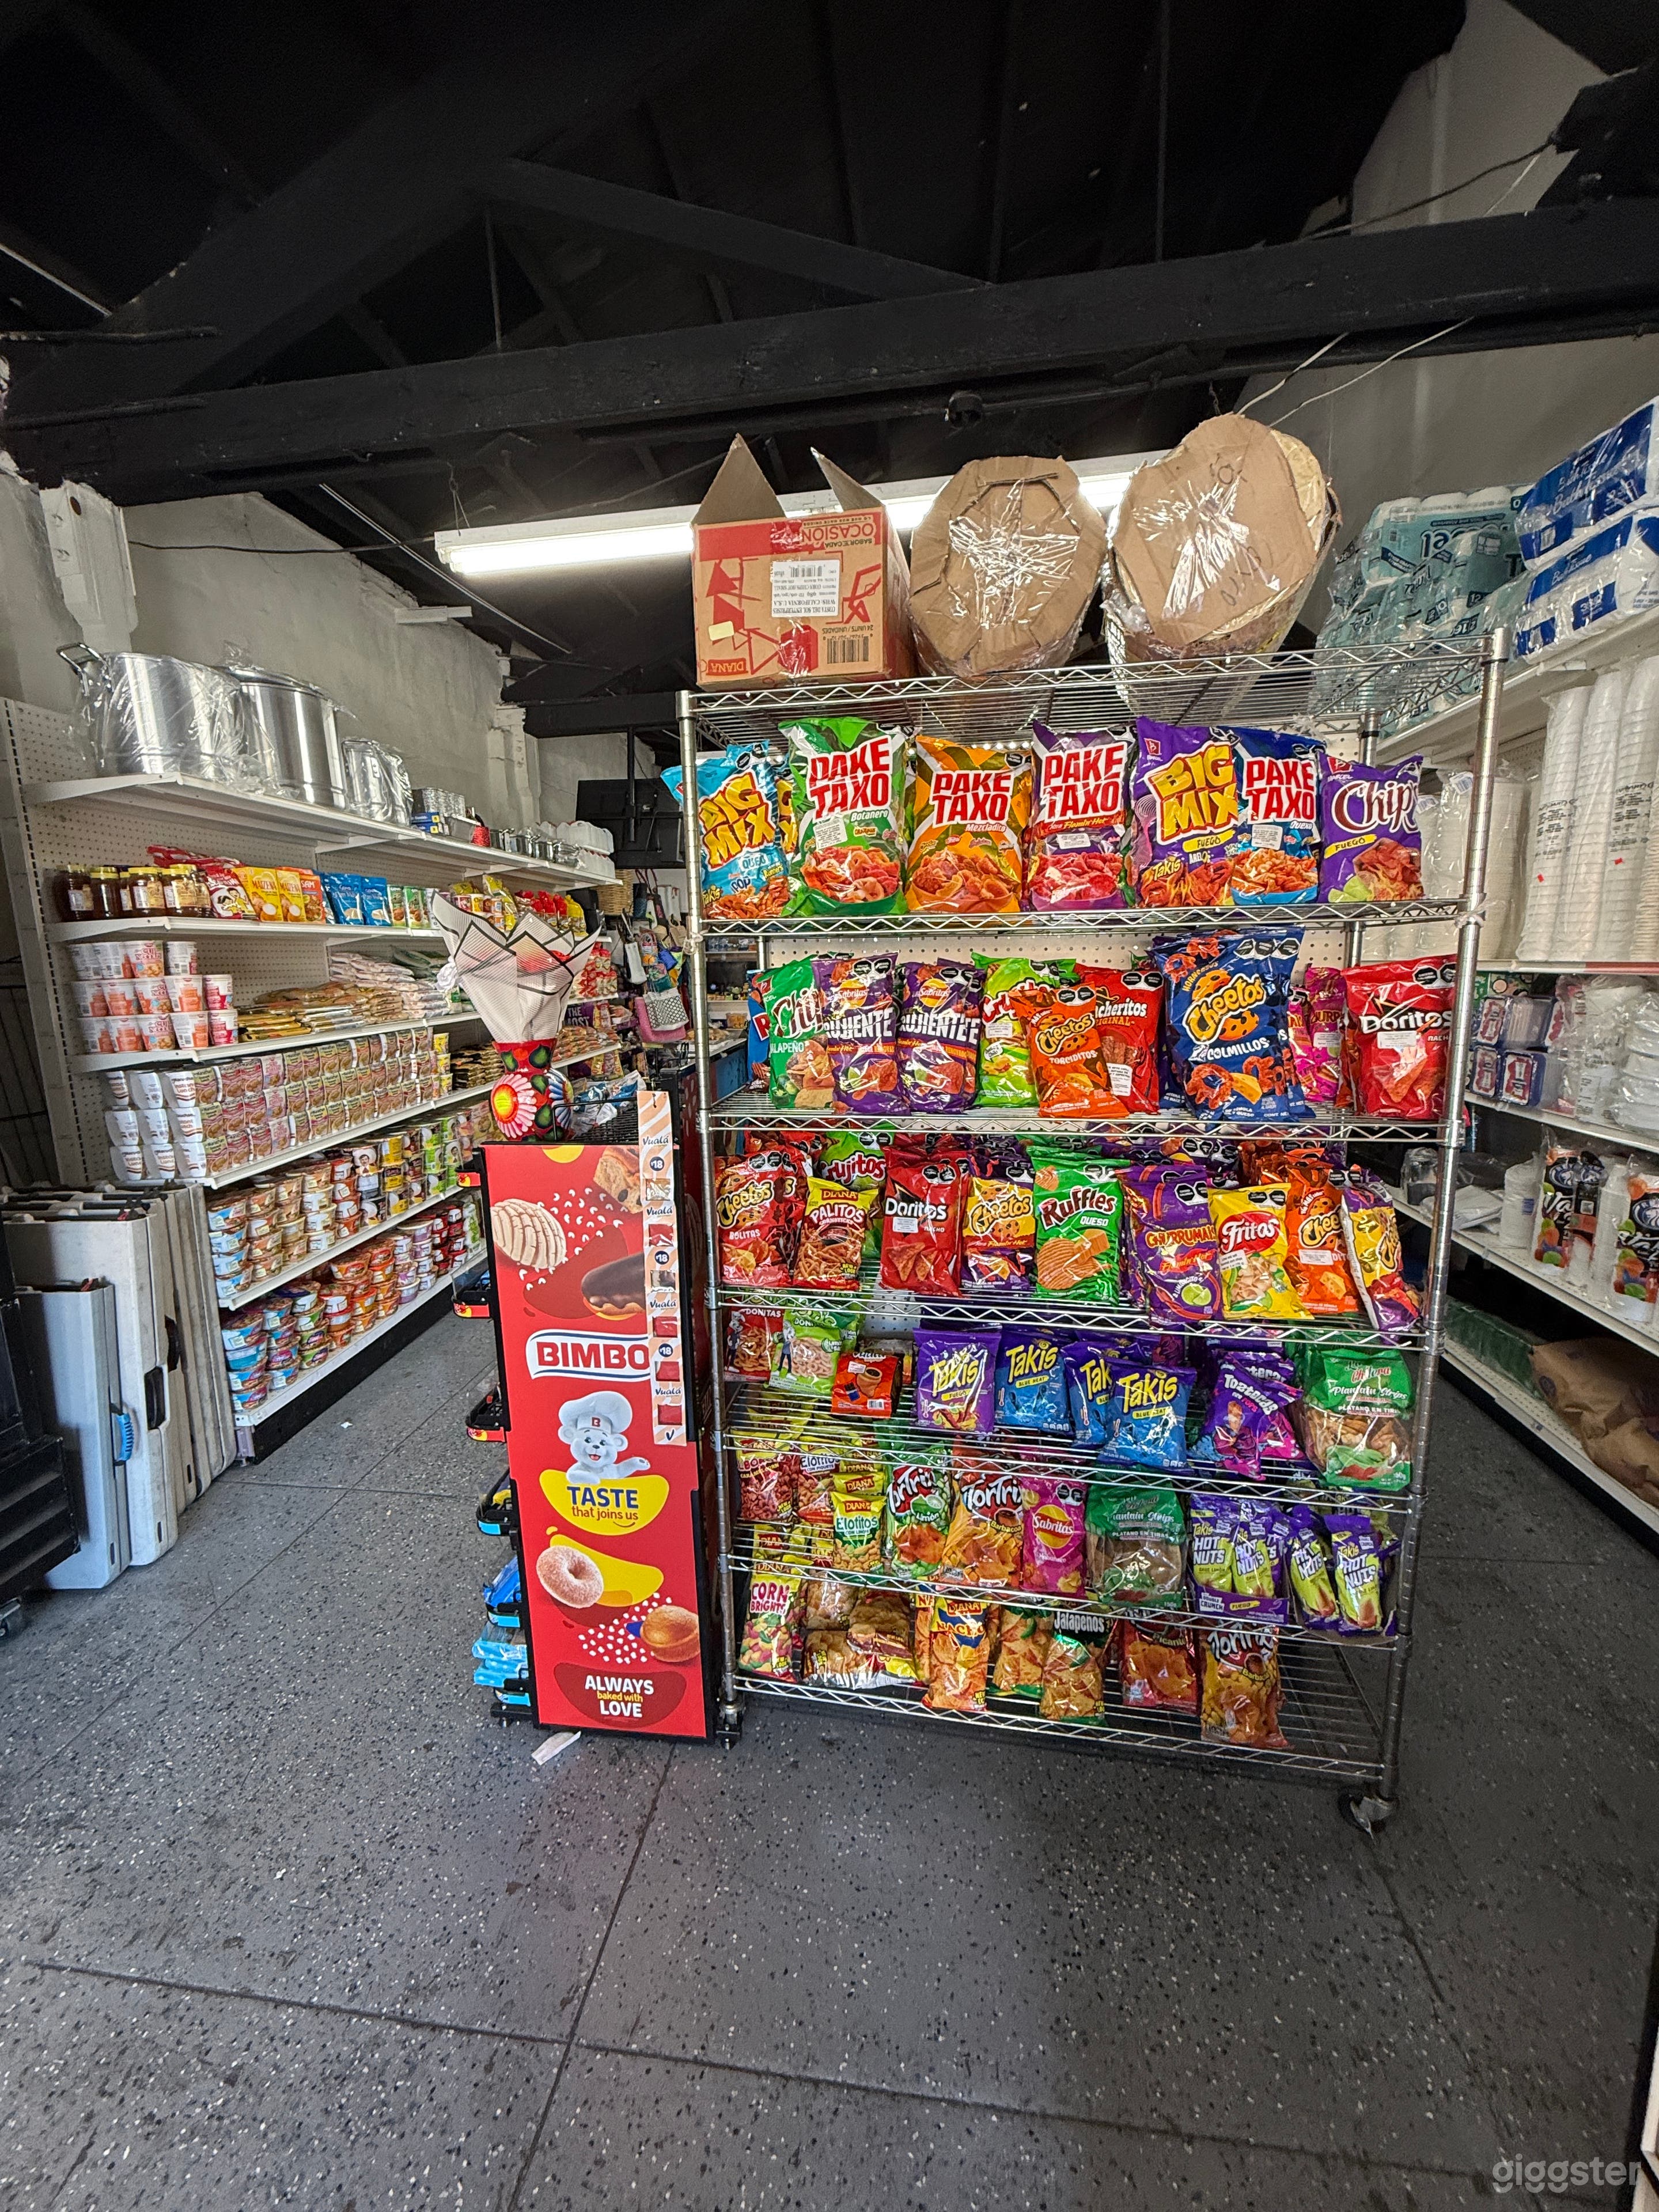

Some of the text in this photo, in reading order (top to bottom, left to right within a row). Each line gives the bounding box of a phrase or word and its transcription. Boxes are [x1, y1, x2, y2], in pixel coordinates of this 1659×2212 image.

[801, 522, 874, 546] OCASIÓN
[850, 538, 872, 547] SABOR
[822, 626, 847, 634] UNIDADES
[710, 661, 744, 673] DIANA
[809, 737, 890, 789] PAKE
[1043, 744, 1125, 787] PAKE
[1151, 744, 1234, 799] BIG
[933, 772, 1012, 796] PAKE
[1246, 759, 1314, 791] PAKE
[699, 772, 762, 830] BIG
[810, 772, 889, 819] TAXO
[1043, 780, 1120, 819] TAXO
[1245, 786, 1315, 821] TAXO
[850, 809, 889, 822] Botanero
[932, 792, 1009, 825] TAXO
[1162, 782, 1238, 841] MIX
[703, 804, 775, 866] MIX
[1197, 834, 1221, 849] FUEGO
[1335, 837, 1366, 851] FUEGO
[1153, 858, 1181, 880] Takis
[838, 988, 869, 999] Sabritas
[919, 987, 950, 997] Sabritas
[567, 1007, 582, 1016] THE
[1095, 998, 1147, 1018] cheritos
[1186, 976, 1265, 1043] Cheetos
[824, 1007, 893, 1039] RUJIENTE
[900, 1011, 967, 1042] RUJIENTE
[1095, 1016, 1131, 1027] RIGINAL
[1359, 1010, 1452, 1034] Doritos
[1036, 1013, 1094, 1056] Cheetos
[1048, 1050, 1097, 1065] TORCIDITOS
[1208, 1038, 1270, 1060] COLMILLOS
[642, 1135, 670, 1146] Vualá
[825, 1152, 887, 1185] rujitos
[716, 1179, 774, 1229] Cheetos
[823, 1190, 858, 1200] DIANA
[646, 1205, 673, 1217] Vualá
[809, 1203, 864, 1225] PALITOS
[885, 1197, 948, 1220] Doritos
[969, 1194, 1034, 1236] Cheetos
[1039, 1186, 1119, 1229] Ruffles
[1080, 1217, 1109, 1227] QUESO
[1298, 1208, 1342, 1248] Chee
[729, 1229, 761, 1240] BOLITAS
[1145, 1225, 1217, 1248] CHURRUMAI
[1221, 1218, 1279, 1254] Fritos
[650, 1298, 677, 1310] Vualá
[746, 1307, 781, 1318] DONITAS
[536, 1342, 650, 1370] BIMBO
[1006, 1344, 1058, 1383] Takis
[929, 1359, 979, 1397] Takis
[1080, 1358, 1112, 1400] Tak
[655, 1385, 681, 1396] Vualá
[949, 1391, 967, 1399] FUEGO
[1118, 1372, 1177, 1414] Takis
[1334, 1385, 1407, 1400] Plantain Strips
[847, 1478, 874, 1491] DIANA
[567, 1485, 639, 1509] TASTE
[571, 1505, 639, 1521] that joins us
[836, 1516, 878, 1530] Elotitos
[916, 1512, 940, 1522] Limón
[1112, 1512, 1145, 1522] antain
[990, 1520, 1022, 1533] Barbacoa
[1033, 1515, 1074, 1535] Sabritas
[1193, 1522, 1214, 1536] Takis
[1195, 1536, 1221, 1551] HOT
[1234, 1538, 1258, 1559] HOT
[1193, 1548, 1226, 1565] NUTS
[1236, 1549, 1265, 1576] NUTS
[1297, 1552, 1323, 1581] NUTS
[1343, 1554, 1368, 1574] HOT
[1344, 1565, 1377, 1589] NUTS
[751, 1582, 790, 1602] CORN
[948, 1602, 981, 1615] DIANA
[1200, 1600, 1224, 1611] CRUNCH
[1232, 1601, 1252, 1609] FUEGO
[585, 1675, 654, 1695] ALWAYS
[597, 1691, 644, 1703] baked with
[600, 1700, 643, 1718] LOVE
